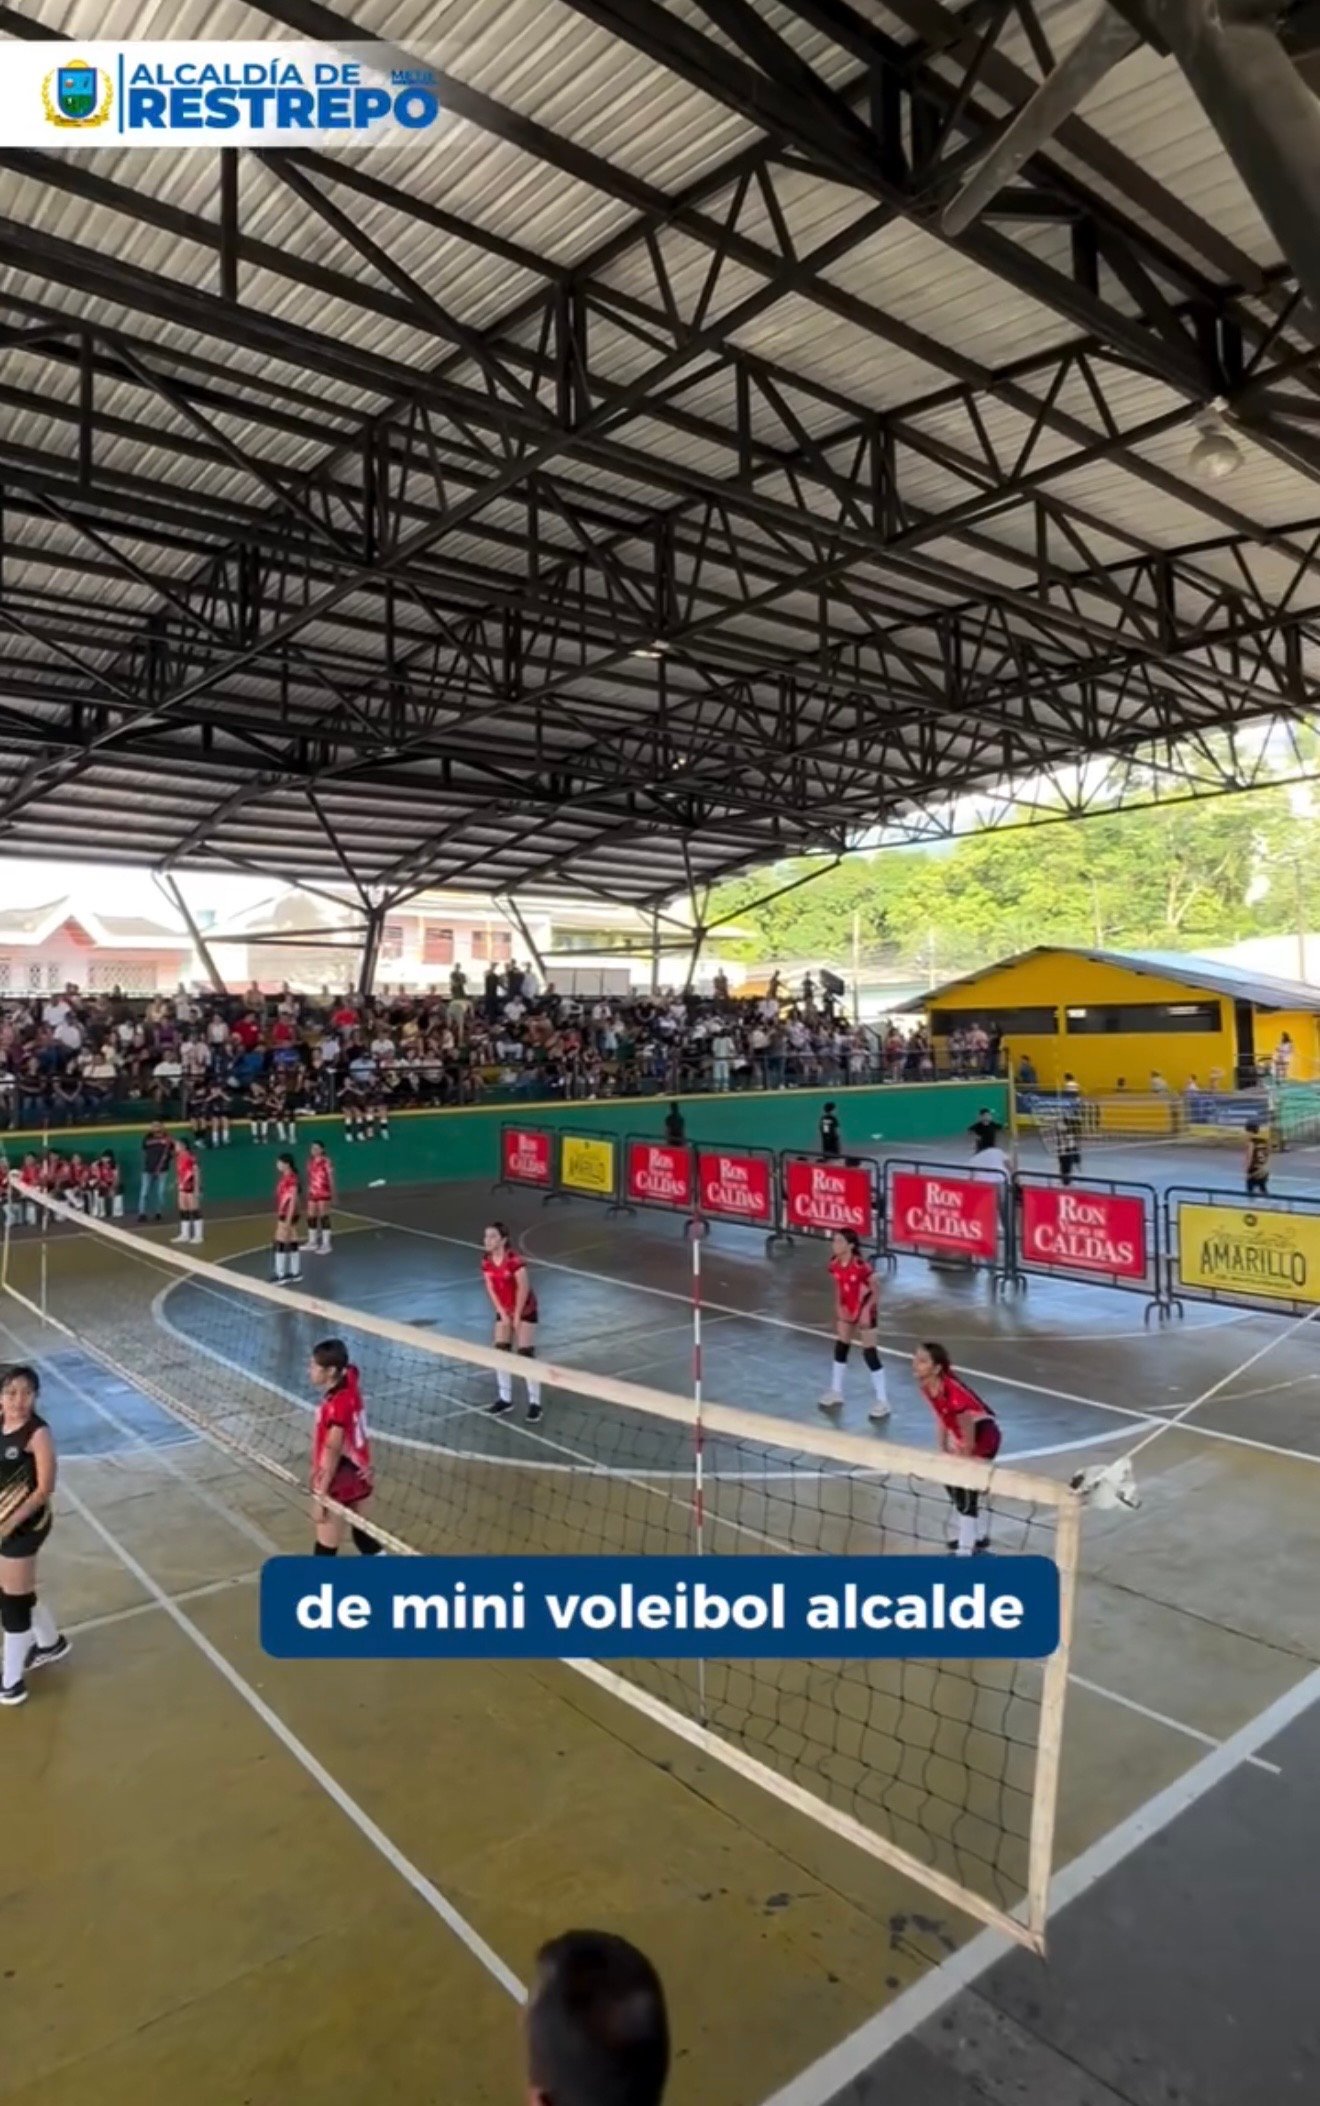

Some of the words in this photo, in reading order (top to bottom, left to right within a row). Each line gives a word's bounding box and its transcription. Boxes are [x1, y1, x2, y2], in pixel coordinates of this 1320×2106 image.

[635, 1171, 686, 1196] CALDAS
[707, 1182, 764, 1209] CALDAS
[926, 1182, 963, 1208] RON
[795, 1193, 864, 1225] CALDAS
[906, 1207, 982, 1241] CALDAS
[1058, 1195, 1106, 1226] RON
[1034, 1225, 1134, 1264] CALDAS
[1200, 1240, 1306, 1287] AMARILLO
